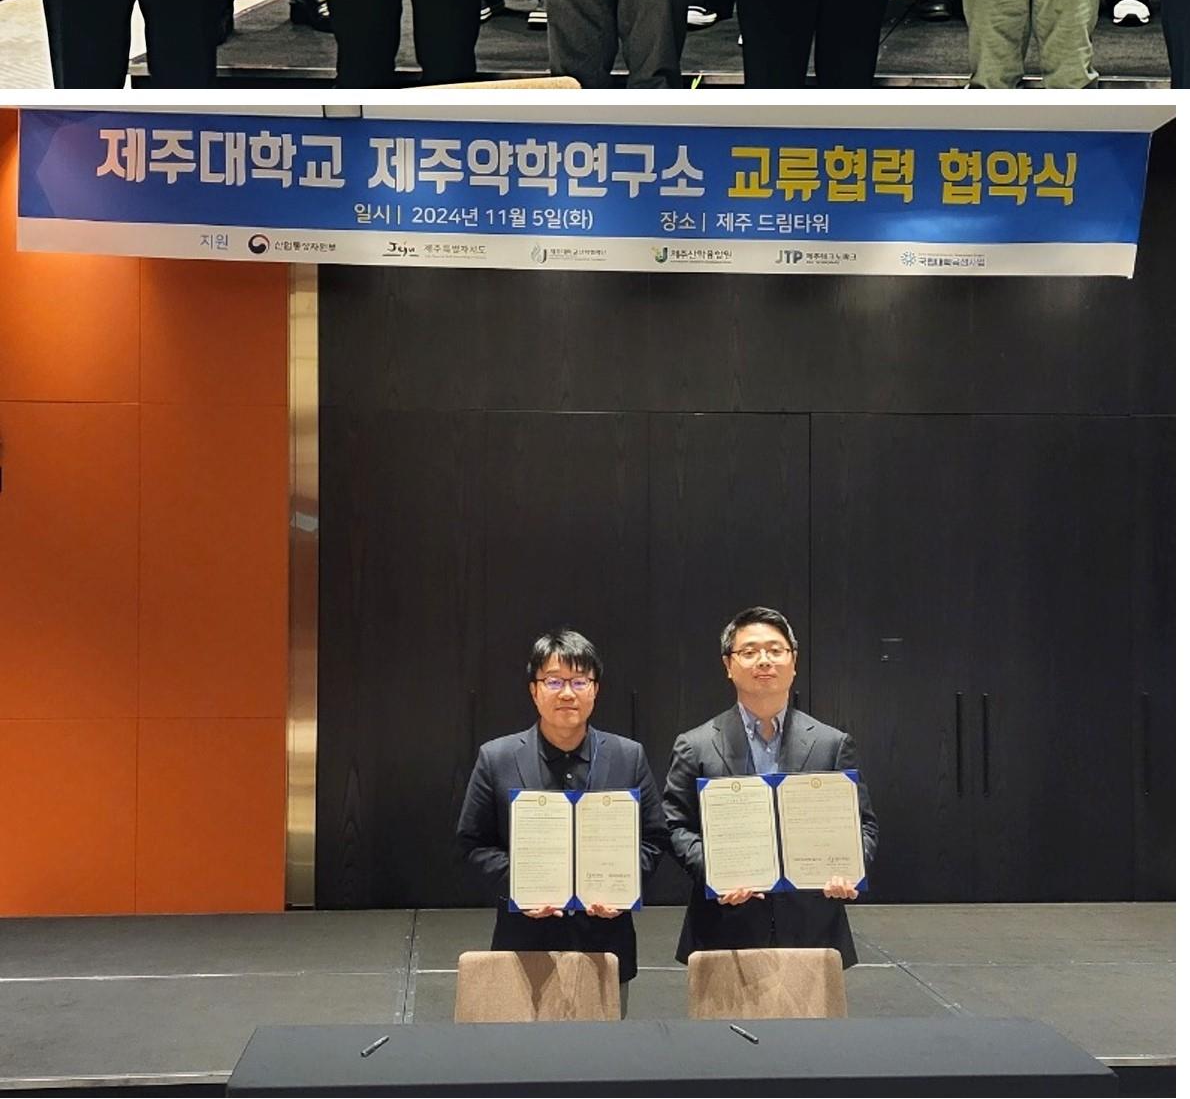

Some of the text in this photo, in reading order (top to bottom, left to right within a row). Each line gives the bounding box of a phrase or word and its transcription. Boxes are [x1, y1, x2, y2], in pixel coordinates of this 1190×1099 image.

[96, 127, 1078, 205] 제주대학교 제주약학연구소 교류협력 협약식
[412, 206, 478, 227] 2024년
[486, 207, 526, 227] 11월
[532, 208, 593, 230] 5일(화)
[716, 212, 752, 233] 제주
[757, 213, 829, 233] 드림타워
[200, 234, 229, 251] 지원
[776, 250, 803, 264] JTP
